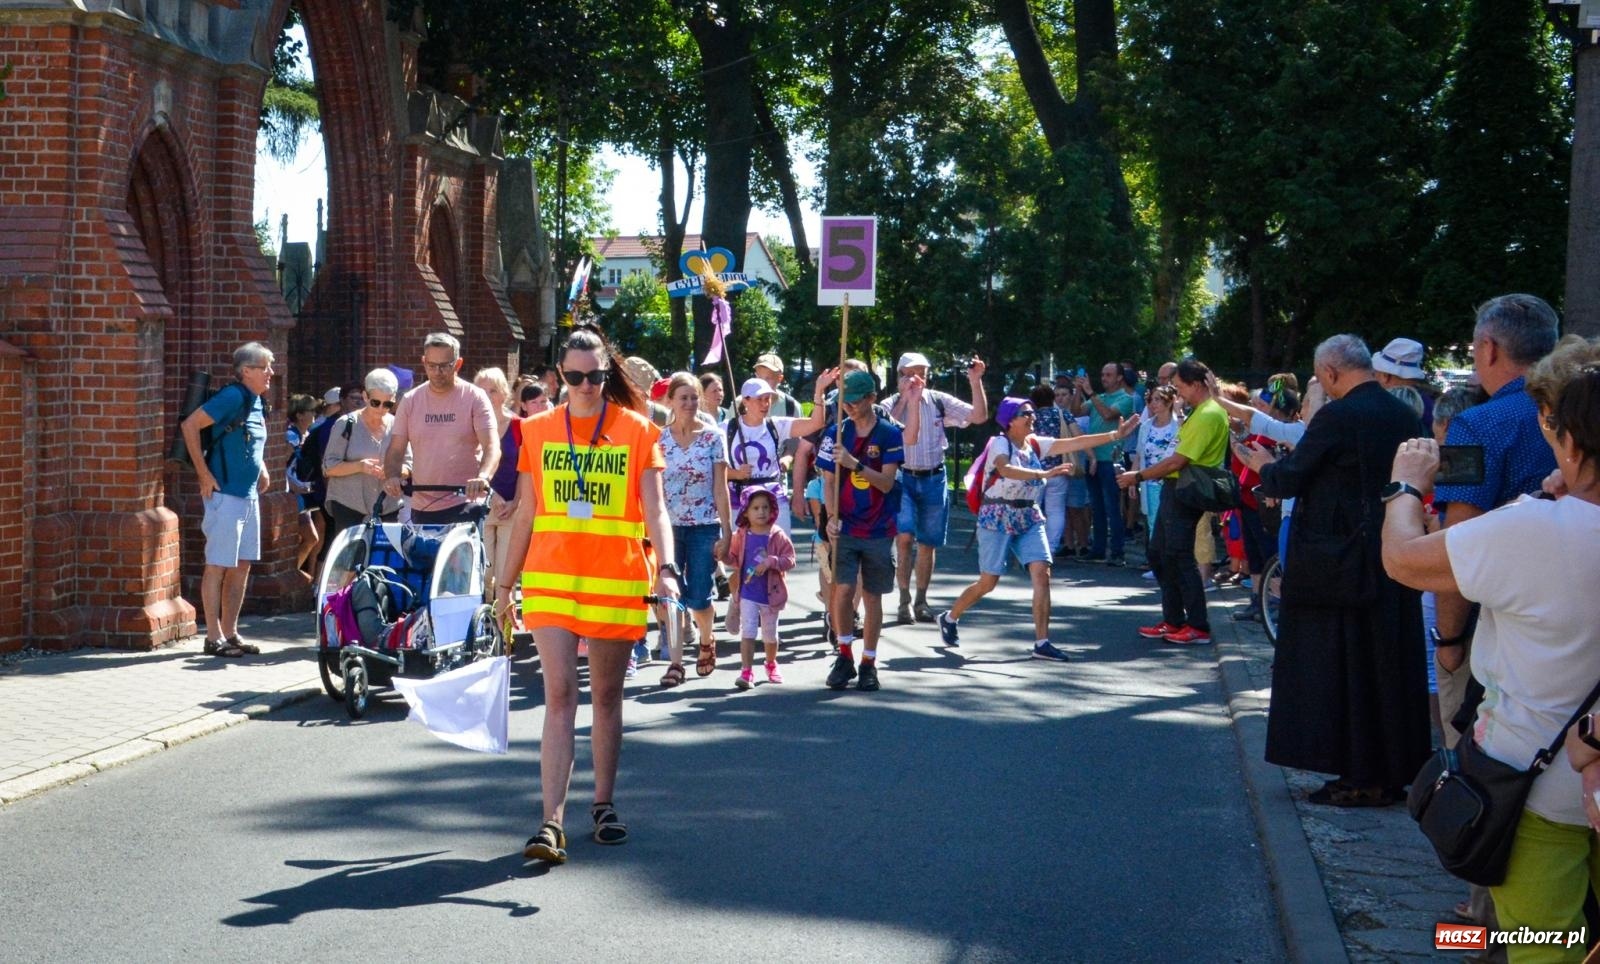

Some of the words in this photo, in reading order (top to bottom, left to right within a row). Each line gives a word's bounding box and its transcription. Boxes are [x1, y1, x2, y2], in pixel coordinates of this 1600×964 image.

[828, 226, 866, 283] 5
[424, 413, 457, 423] DYNAMIC
[543, 449, 627, 476] KIEROWANIE
[553, 479, 611, 506] RUCHEM
